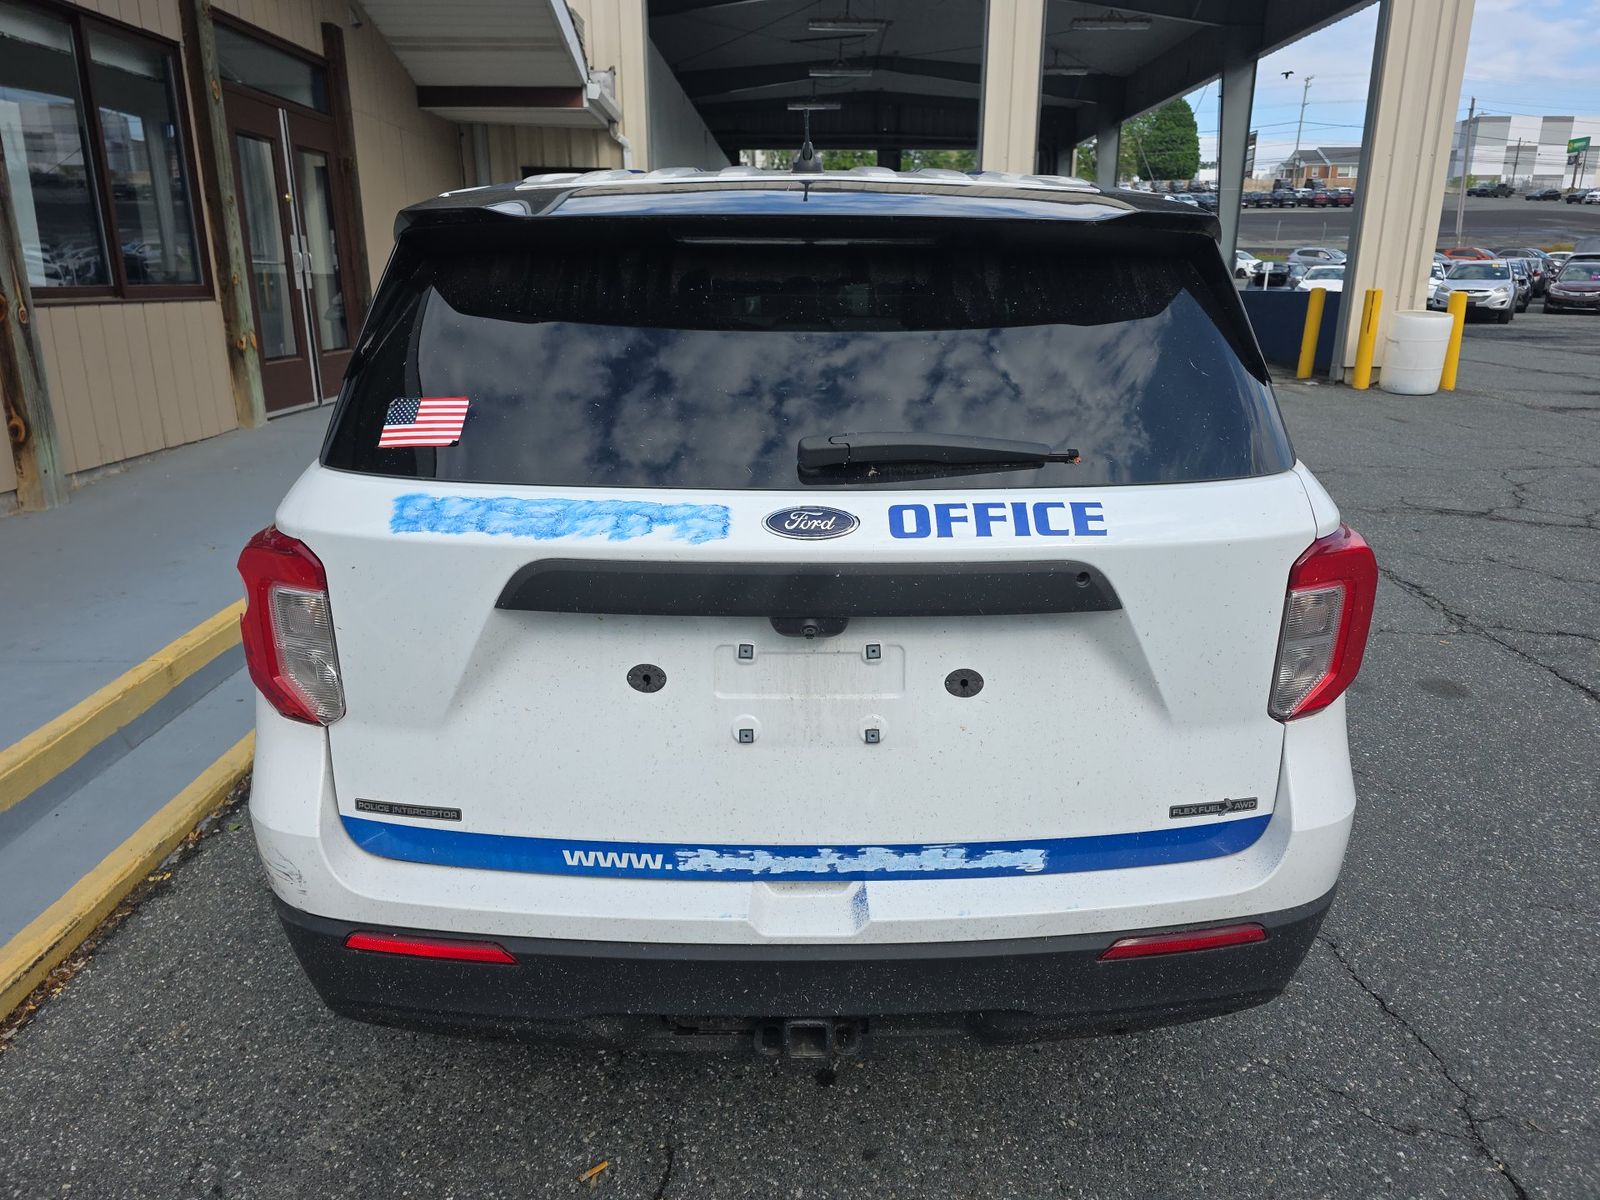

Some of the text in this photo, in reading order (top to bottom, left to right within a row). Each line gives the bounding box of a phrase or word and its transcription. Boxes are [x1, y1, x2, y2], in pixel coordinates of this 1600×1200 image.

[784, 511, 836, 532] Ford
[888, 502, 1108, 539] OFFICE
[358, 801, 459, 819] POLICE INTERCEPTOR
[1172, 800, 1256, 816] FLEX FUEL AWD
